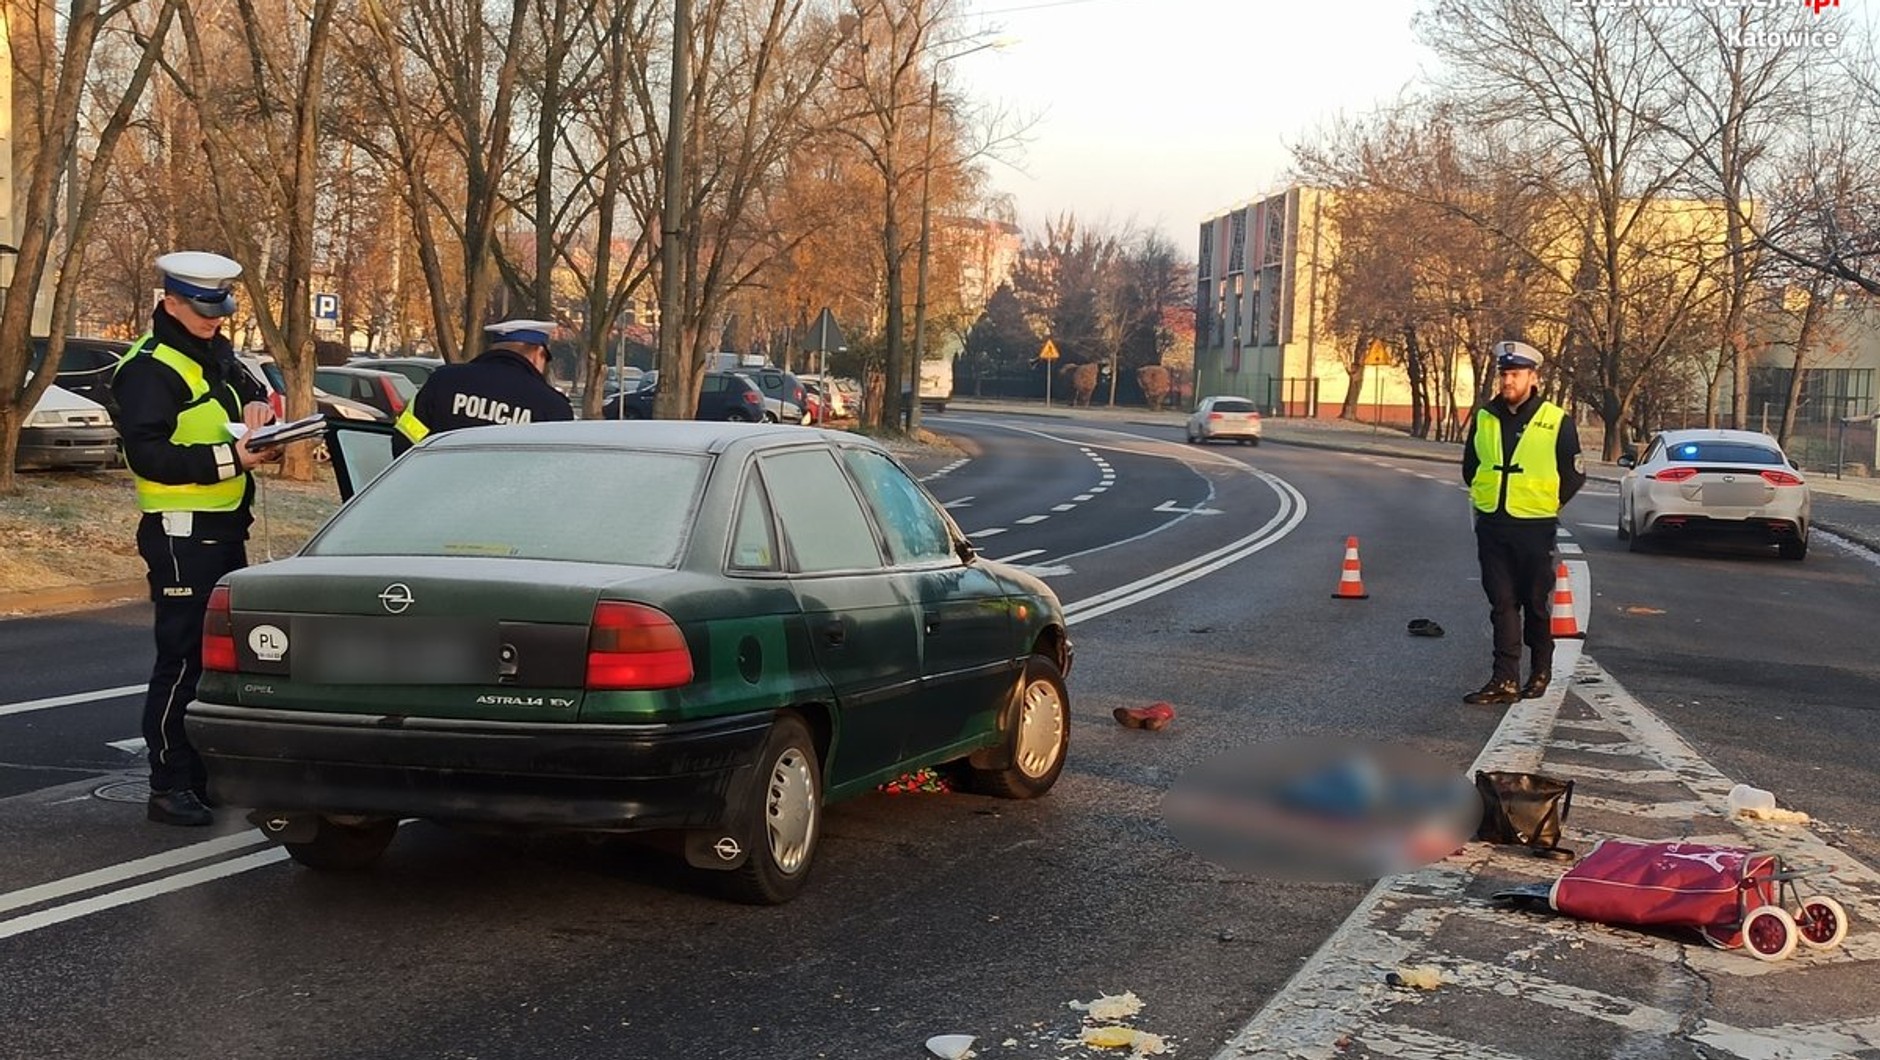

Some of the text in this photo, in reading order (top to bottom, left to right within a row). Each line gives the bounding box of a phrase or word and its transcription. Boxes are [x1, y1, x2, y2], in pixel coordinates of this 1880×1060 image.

[320, 296, 335, 317] P
[452, 393, 532, 425] POLICJA
[260, 634, 279, 649] PL
[476, 695, 521, 705] ASTRA
